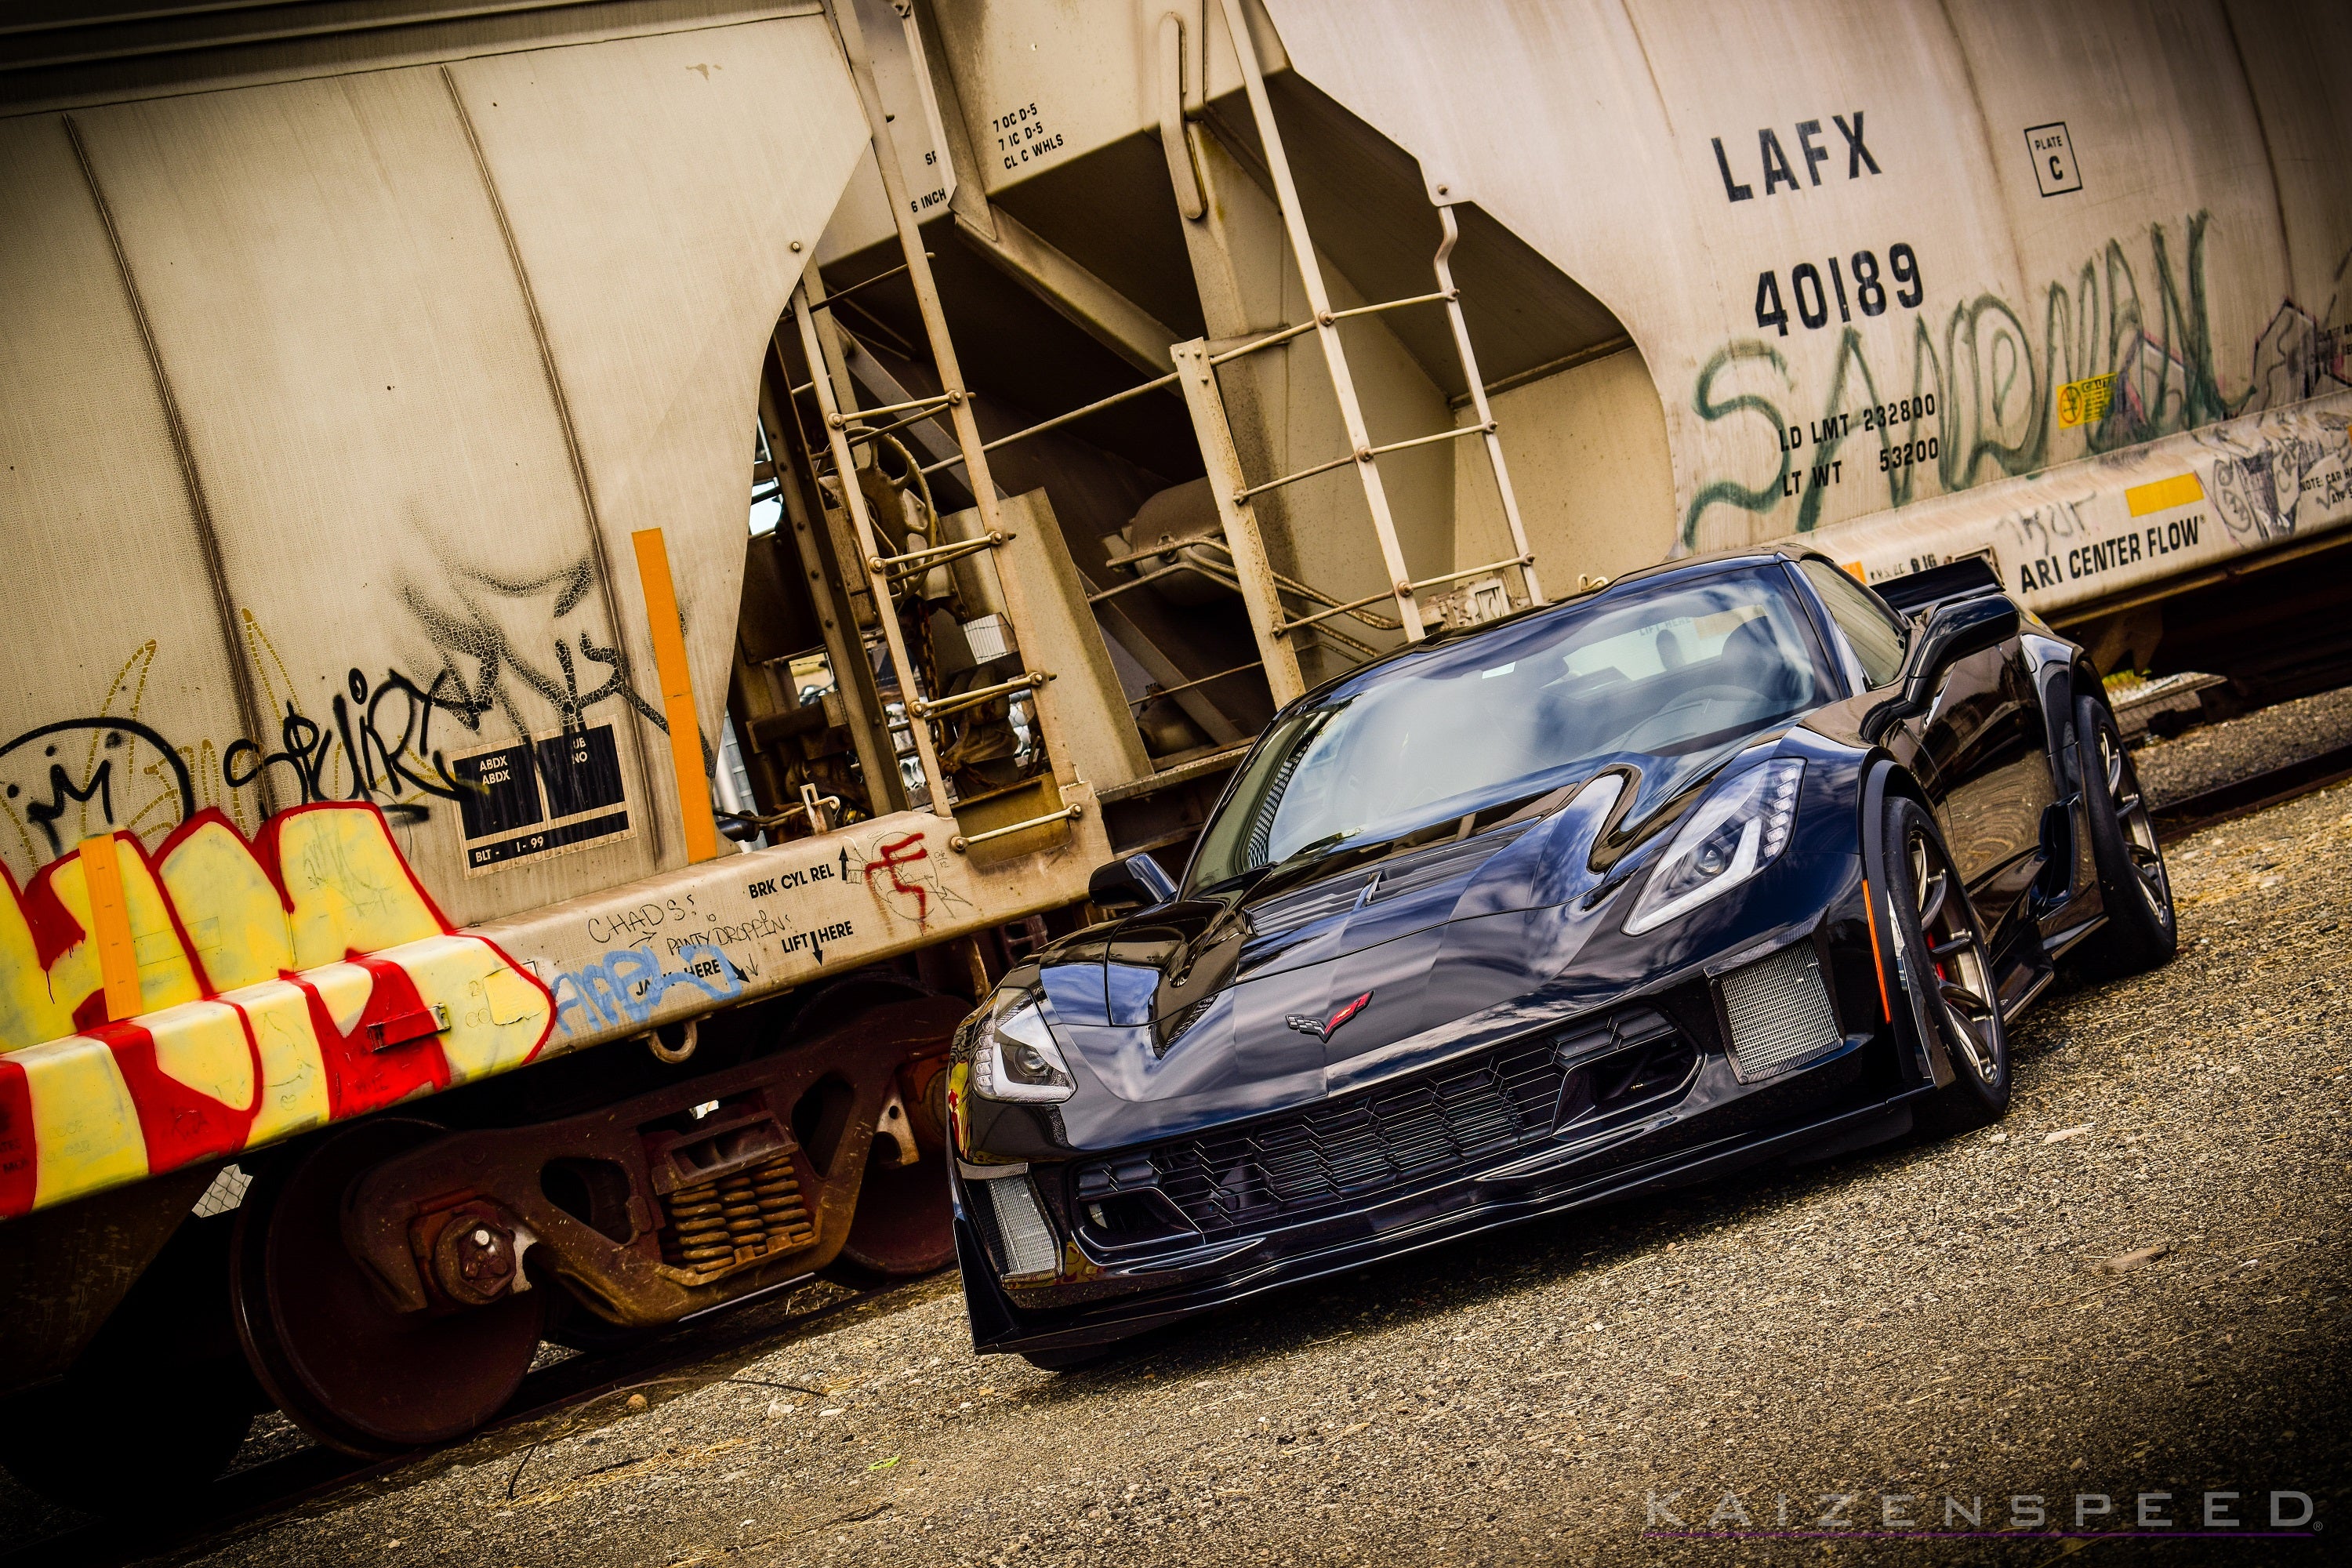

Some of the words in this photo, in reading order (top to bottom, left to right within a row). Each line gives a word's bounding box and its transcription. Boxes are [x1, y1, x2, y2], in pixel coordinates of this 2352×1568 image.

[993, 120, 1000, 132] 7
[1019, 103, 1037, 121] D-5
[998, 139, 1004, 151] 7
[1025, 122, 1044, 140] D-5
[1004, 155, 1018, 169] CL
[1021, 150, 1029, 162] C
[1032, 133, 1064, 157] WHLS
[2034, 134, 2063, 151] PLATE
[1711, 111, 1882, 202] LAFX
[2049, 155, 2063, 180] C
[911, 201, 918, 212] 6
[920, 188, 946, 209] INCH
[1755, 242, 1924, 337] 40189
[1779, 426, 1802, 452] LD
[1812, 413, 1850, 444] LMT
[1864, 394, 1936, 431] 232800
[1783, 470, 1801, 497] LT
[1812, 461, 1842, 488] WT
[1880, 437, 1939, 472] 53200
[2021, 557, 2062, 593] ARI
[2069, 532, 2141, 579] CENTER
[479, 755, 508, 772] ABDX
[572, 751, 588, 764] NO
[481, 769, 511, 786] ABDX
[749, 878, 778, 899] BRK
[781, 870, 808, 889] CYL
[811, 862, 834, 882] REL
[782, 932, 809, 954] LIFT
[819, 920, 853, 942] HERE
